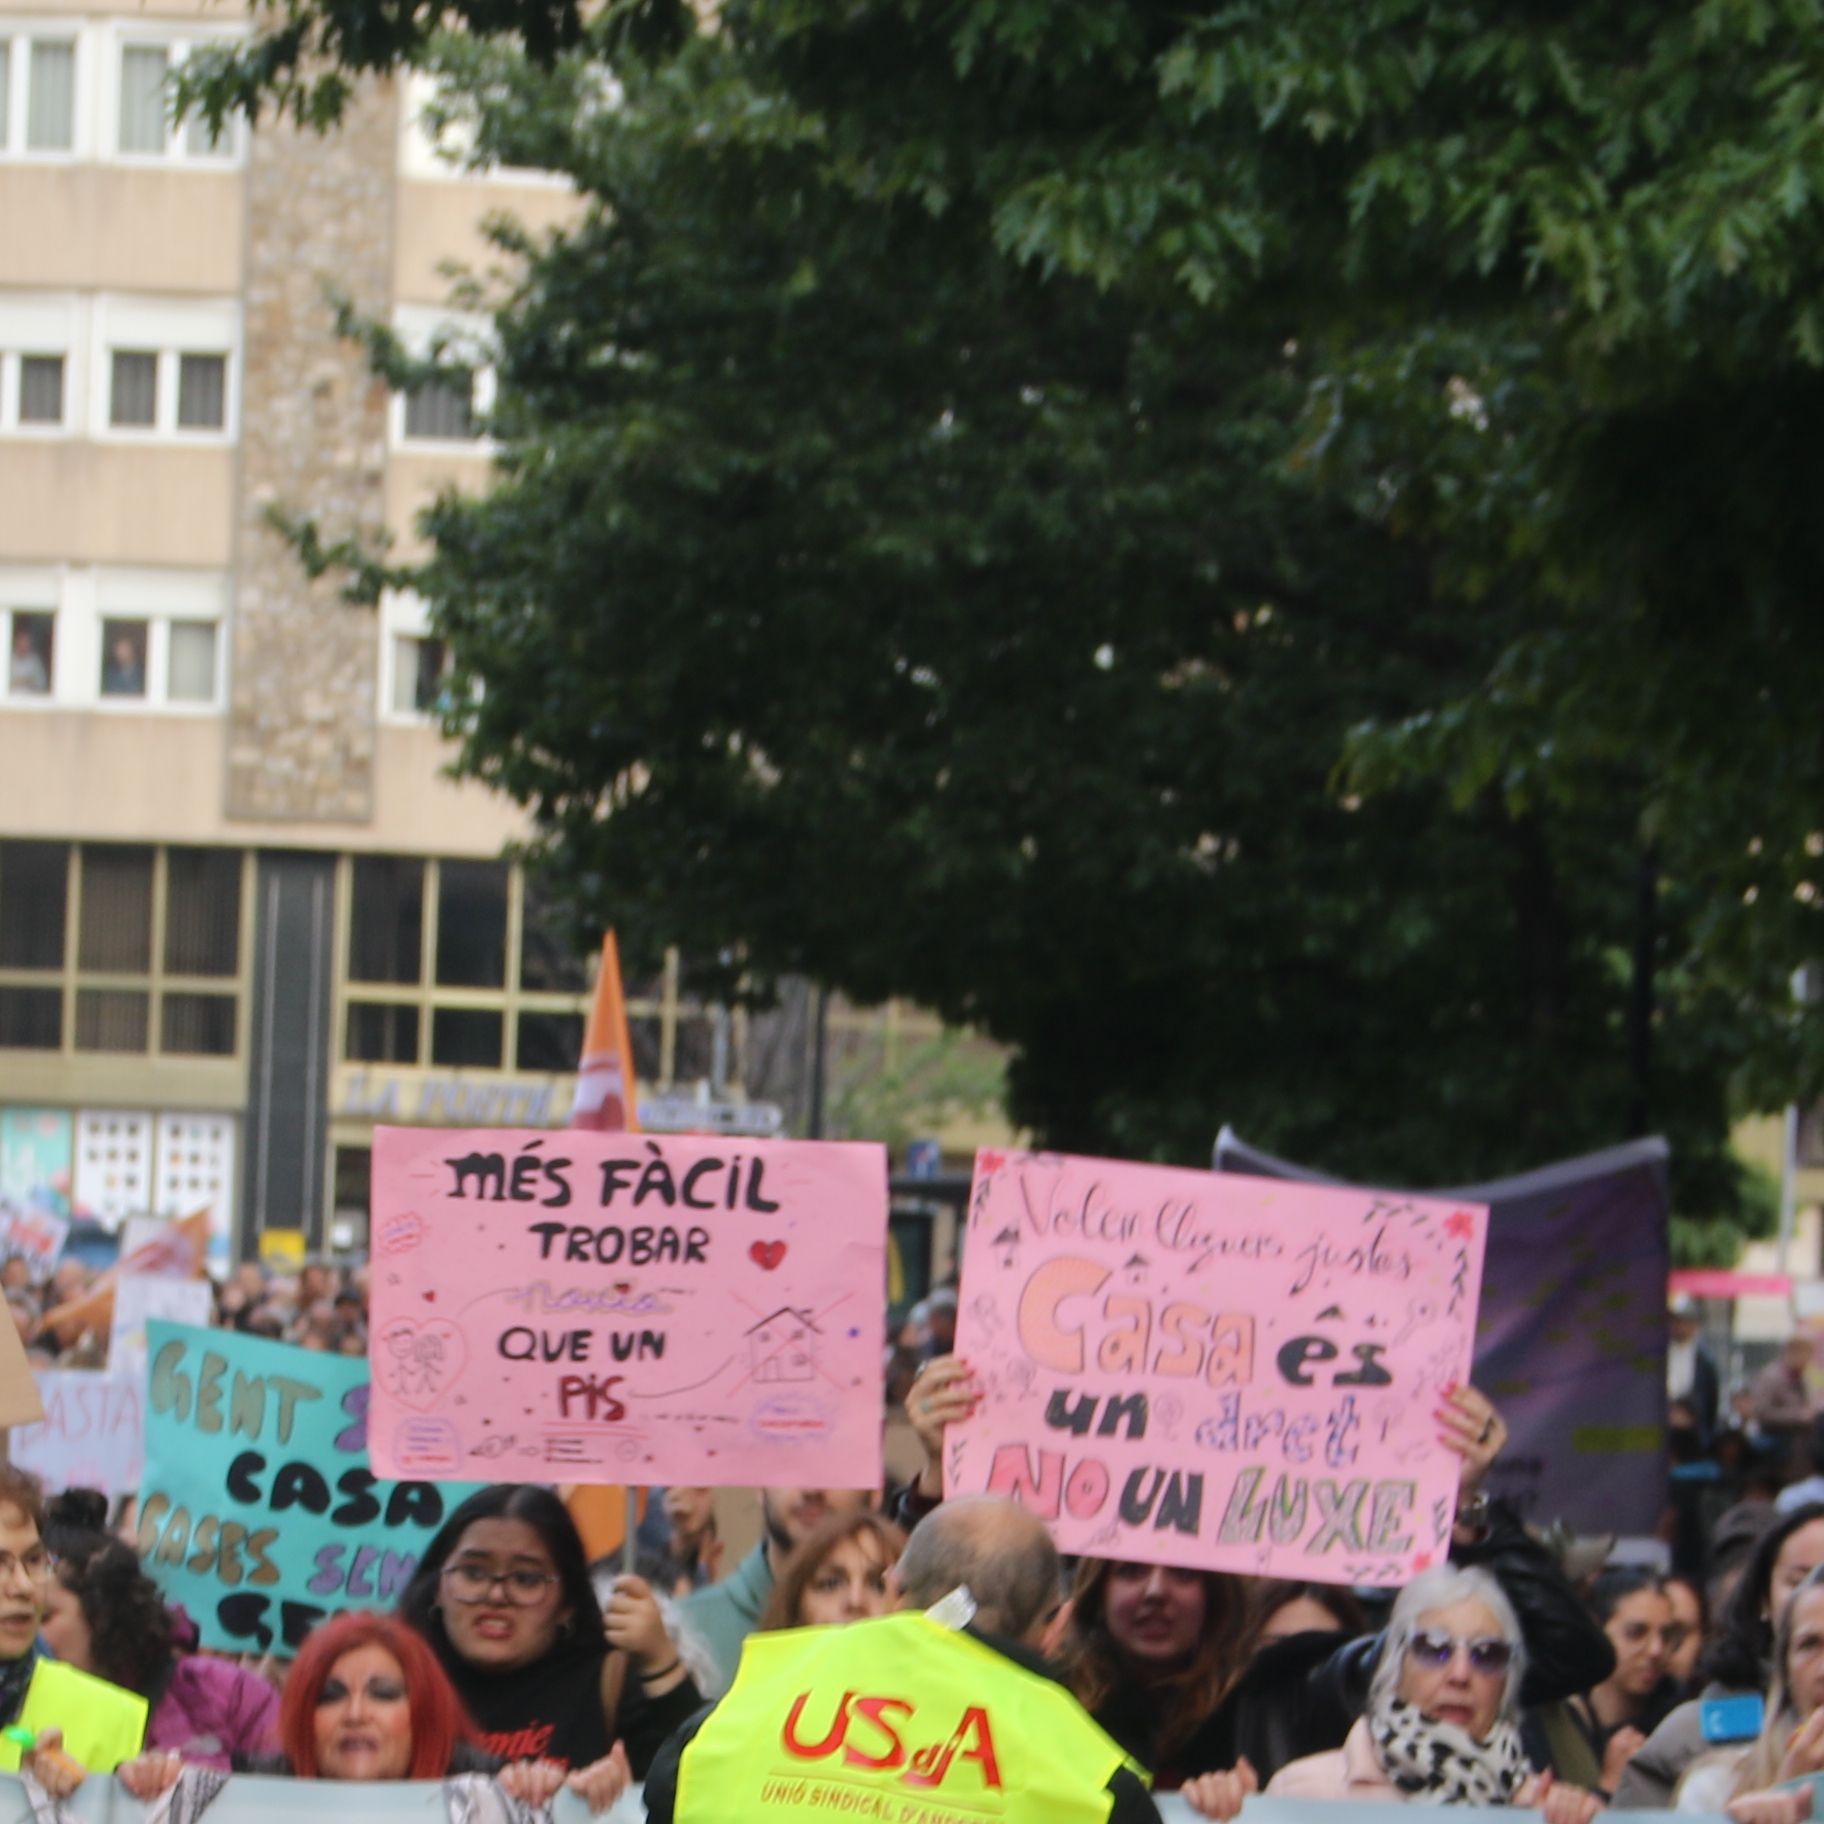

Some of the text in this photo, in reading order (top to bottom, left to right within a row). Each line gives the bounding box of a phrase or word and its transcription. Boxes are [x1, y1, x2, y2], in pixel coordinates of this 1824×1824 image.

[444, 1138, 573, 1208] MÉS
[528, 1221, 711, 1265] TROBAR
[498, 1326, 666, 1364] QUE UN
[1017, 1255, 1256, 1388] Casa
[150, 1339, 324, 1446] GENT
[1044, 1388, 1149, 1441] un
[226, 1450, 445, 1530] CASA
[987, 1442, 1111, 1522] NO
[1119, 1465, 1204, 1537] UN
[1217, 1466, 1418, 1557] LUXE
[137, 1492, 280, 1586] CASES
[760, 1777, 807, 1803] UNIÓ
[807, 1788, 894, 1822] SINDICAL
